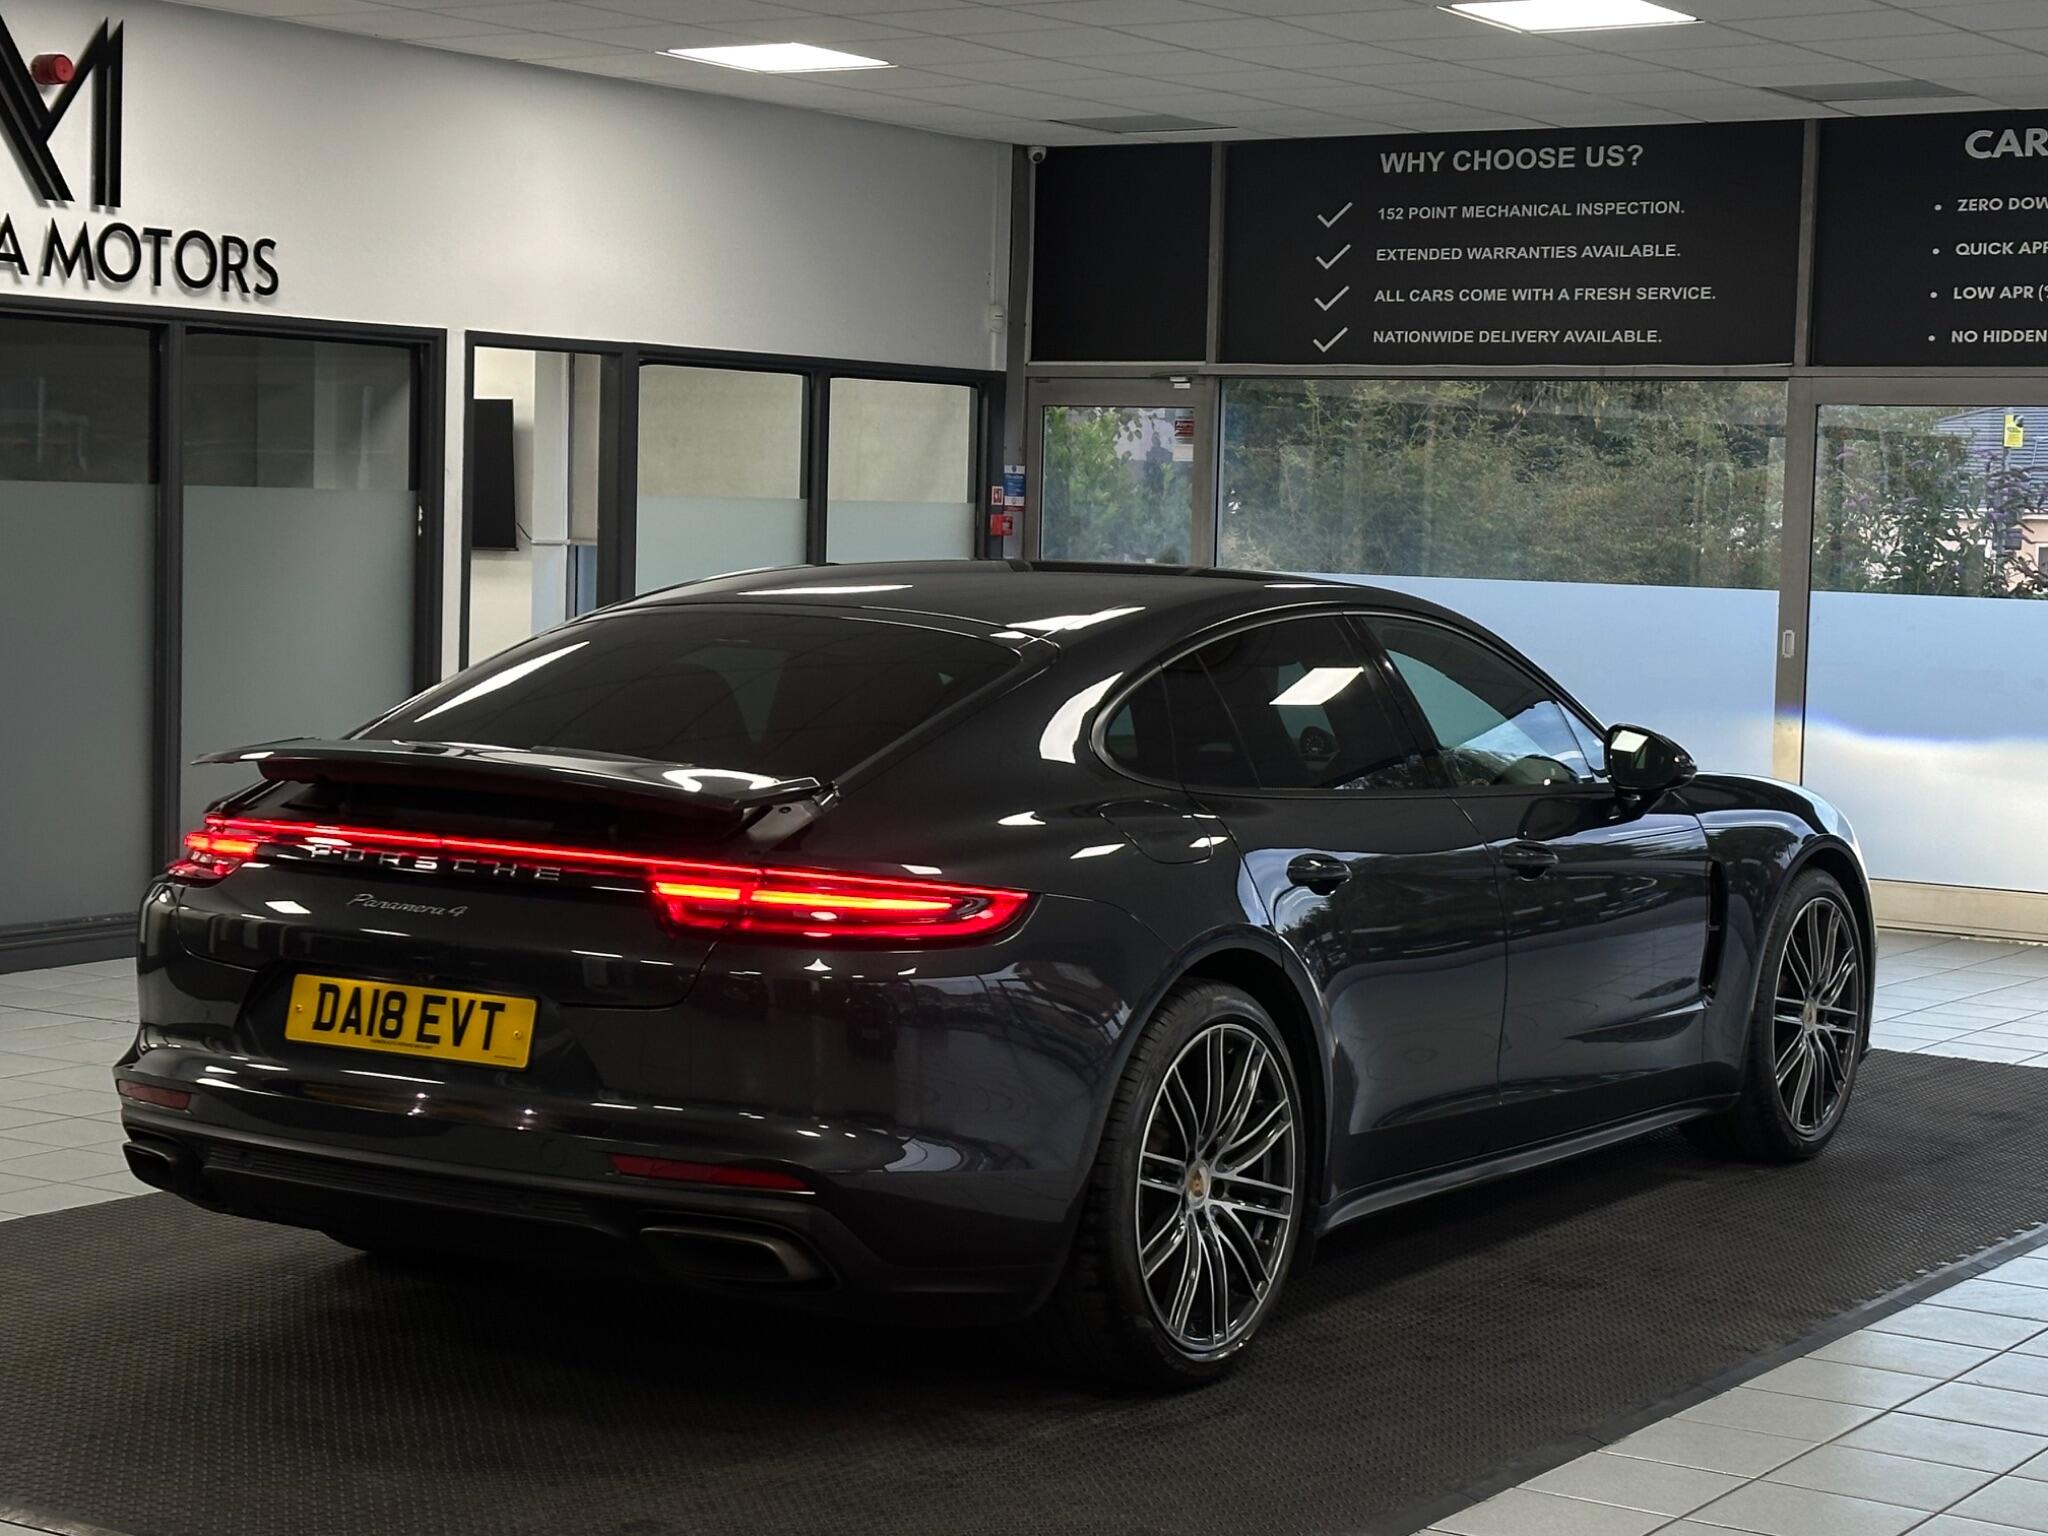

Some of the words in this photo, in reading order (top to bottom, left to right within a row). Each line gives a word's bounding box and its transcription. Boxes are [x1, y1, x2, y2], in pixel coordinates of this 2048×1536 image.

[1964, 127, 2048, 159] CAR
[1380, 151, 1445, 174] WHY
[1452, 146, 1576, 172] CHOOSE
[1586, 144, 1644, 168] US?
[1378, 207, 1404, 220] 152
[1408, 206, 1458, 220] POINT
[1461, 203, 1572, 219] MECHANICAL
[1576, 200, 1685, 216] INSPECTION.
[1957, 197, 2004, 212] ZERO
[43, 217, 279, 296] MOTORS
[1376, 247, 1463, 261] EXTENDED
[1466, 245, 1578, 260] WARRANTIES
[1580, 243, 1681, 258] AVAILABLE.
[1955, 241, 2014, 256] QUICK
[1373, 289, 1405, 303] ALL
[1409, 288, 1454, 303] CARS
[1458, 288, 1508, 302] COME
[1511, 287, 1554, 301] WITH
[1557, 287, 1570, 301] A
[1574, 287, 1631, 301] FRESH
[1635, 286, 1716, 301] SERVICE.
[1953, 286, 1996, 300] LOW
[1999, 285, 2034, 299] APR
[1373, 330, 1474, 343] NATIONWIDE
[1478, 330, 1561, 343] DELIVERY
[1562, 329, 1662, 343] AVAILABLE.
[1951, 330, 1979, 343] NO
[1983, 329, 2048, 343] HIDDEN
[310, 843, 561, 881] PORSCHE
[347, 893, 445, 916] Panamera
[448, 904, 468, 917] 4
[312, 983, 408, 1040] DA18
[416, 994, 506, 1051] EVT
